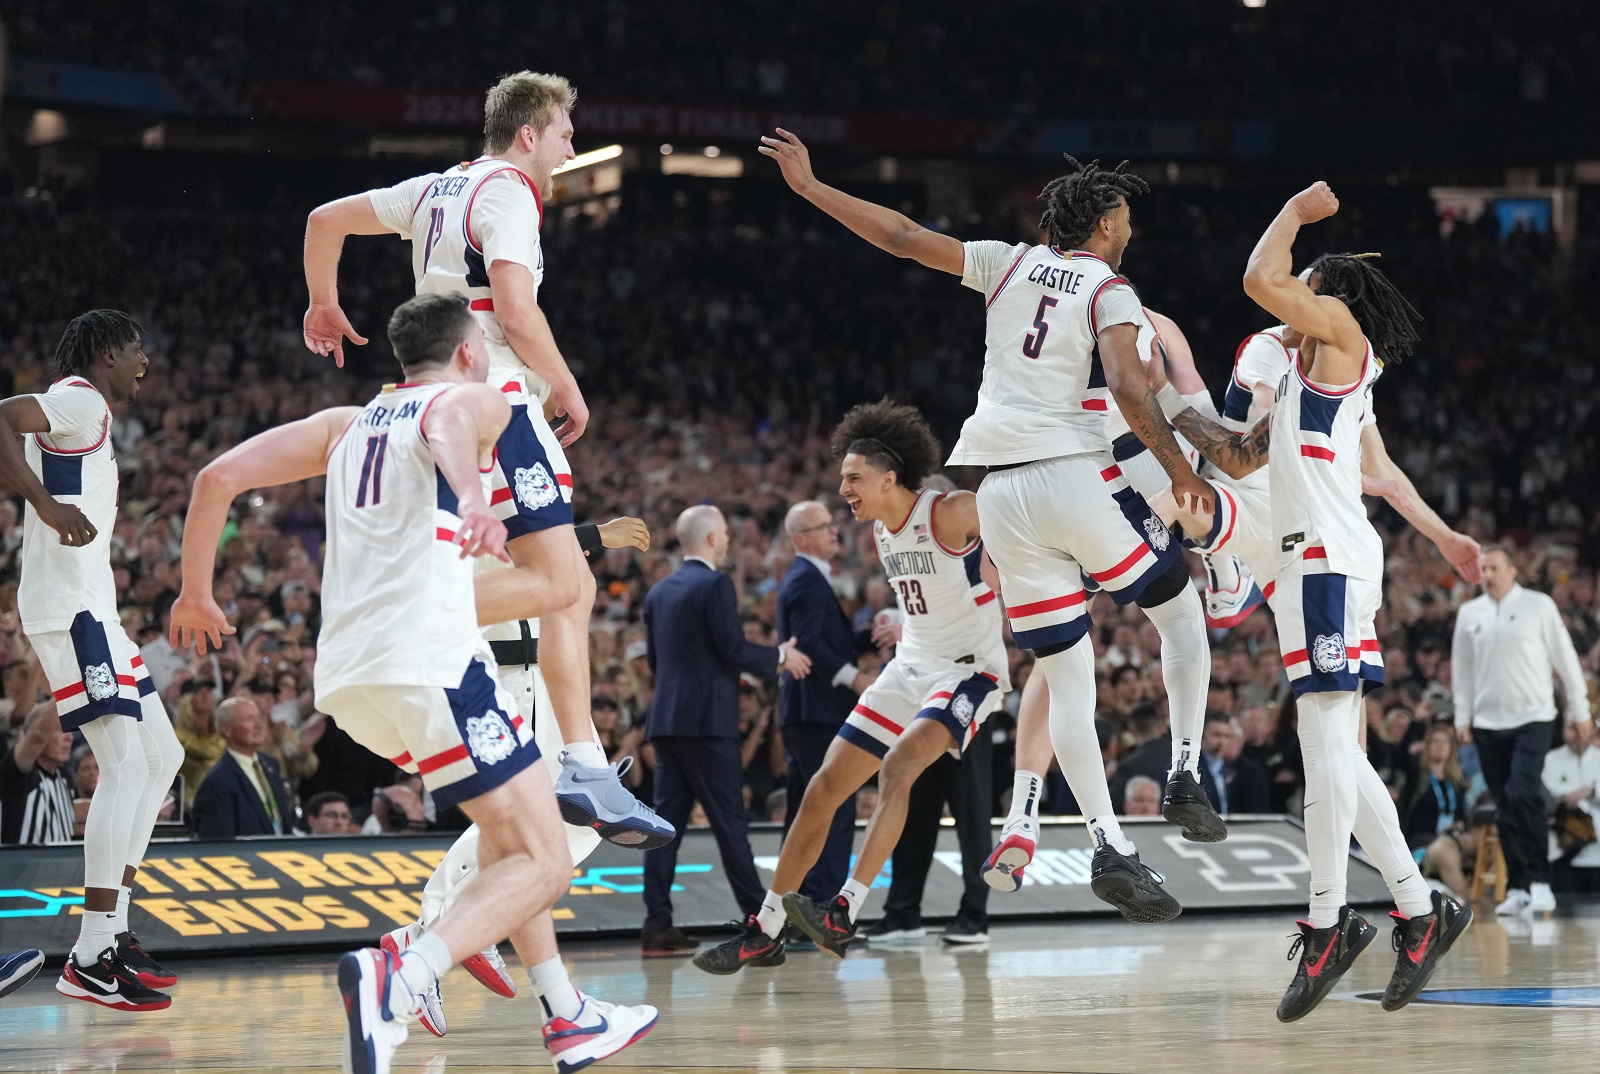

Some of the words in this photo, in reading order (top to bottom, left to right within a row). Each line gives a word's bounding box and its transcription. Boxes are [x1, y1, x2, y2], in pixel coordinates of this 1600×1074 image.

[1028, 263, 1085, 295] CASTLE
[1022, 294, 1059, 360] 5
[355, 432, 389, 508] 11
[898, 579, 929, 616] 23
[134, 856, 280, 893] THE
[131, 895, 370, 936] ENDS
